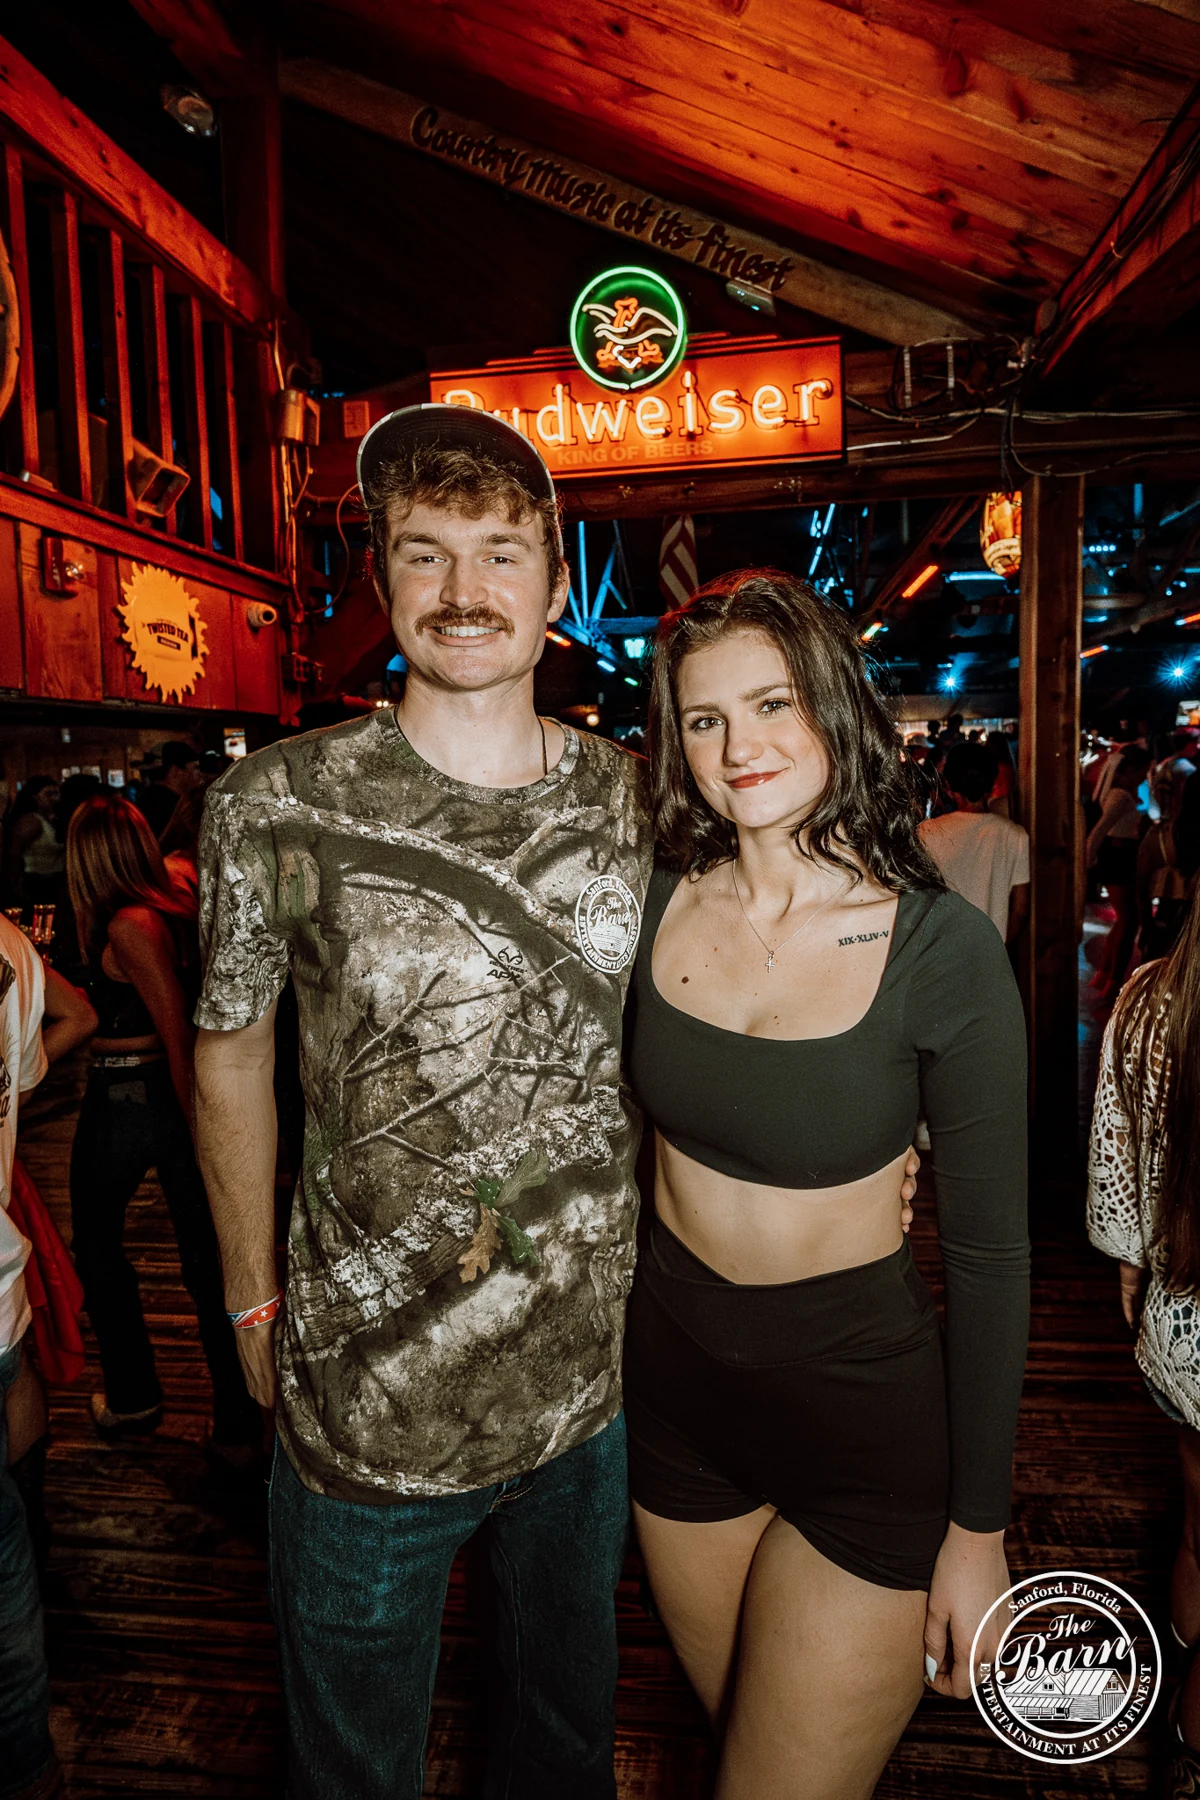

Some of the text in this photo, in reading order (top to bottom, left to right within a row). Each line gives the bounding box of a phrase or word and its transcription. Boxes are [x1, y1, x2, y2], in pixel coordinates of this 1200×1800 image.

[411, 105, 796, 291] Country Music at its finest
[557, 440, 714, 466] KING OF BEERS
[147, 622, 176, 636] TWISTED
[177, 627, 189, 643] TEA
